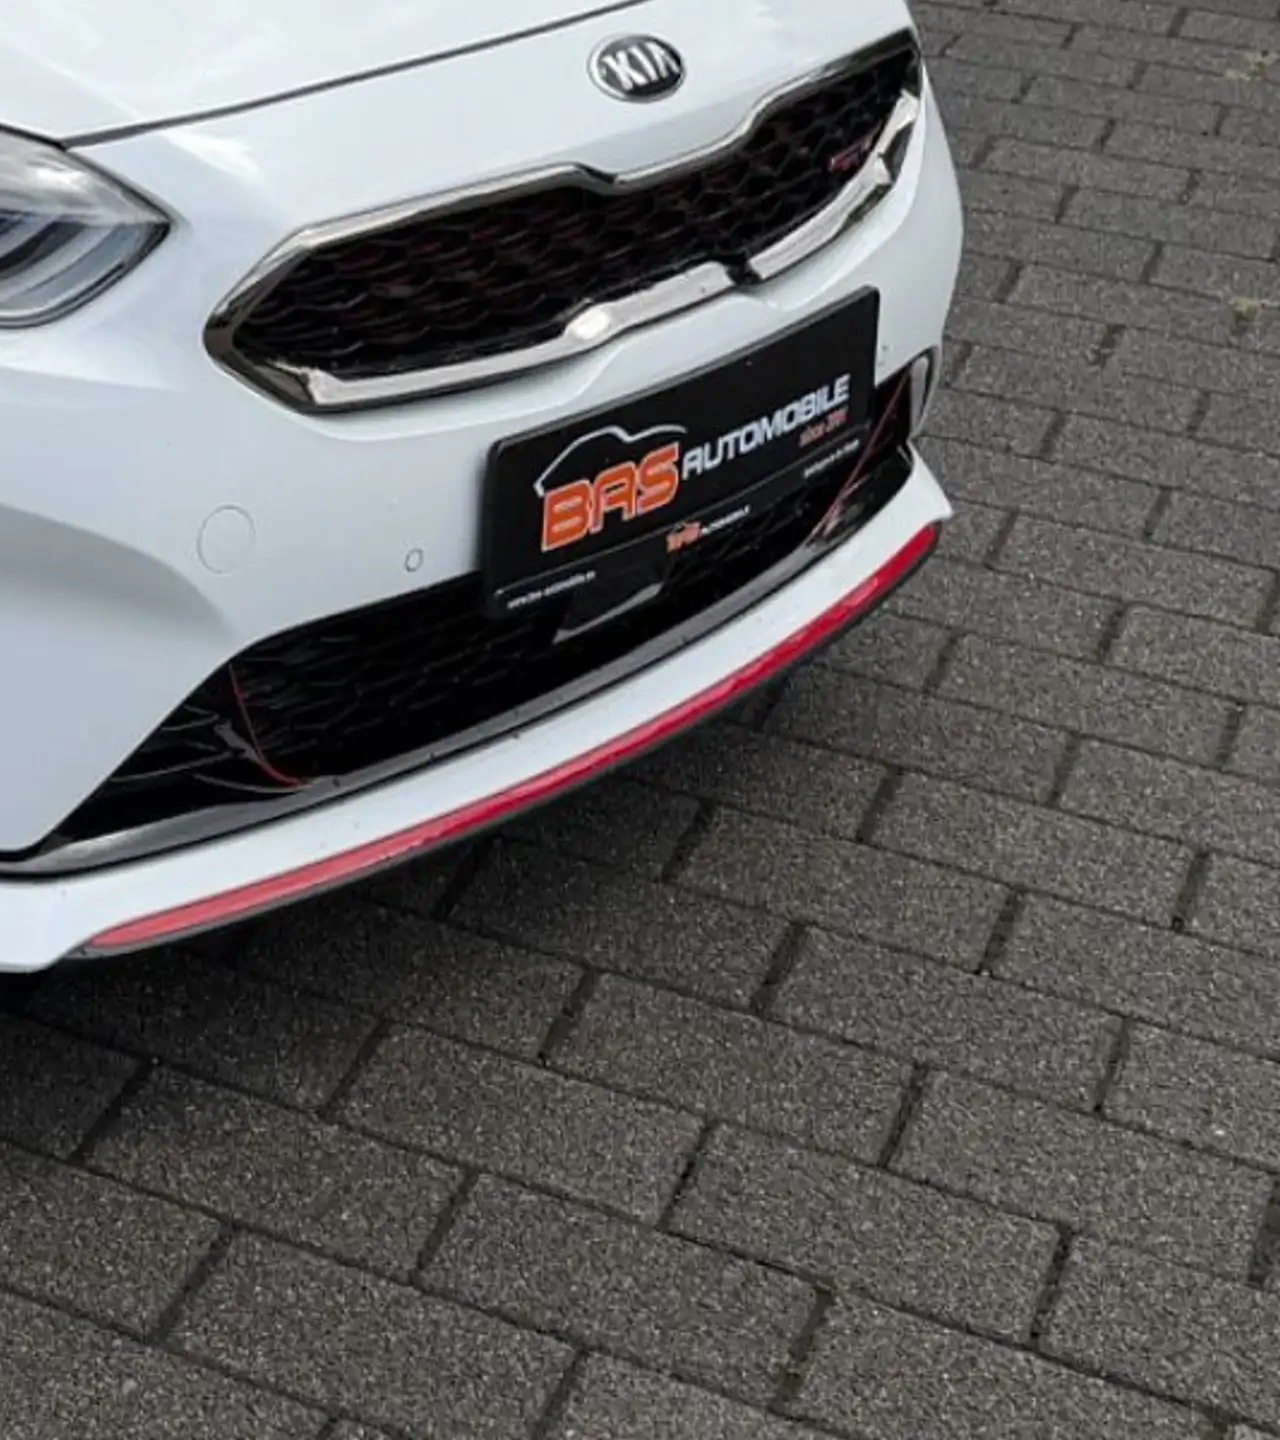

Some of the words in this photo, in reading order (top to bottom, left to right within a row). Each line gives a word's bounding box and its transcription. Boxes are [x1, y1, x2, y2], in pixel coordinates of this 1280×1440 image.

[601, 41, 680, 91] KIA
[541, 441, 681, 552] BAS
[681, 373, 851, 481] AUTOMOBILE
